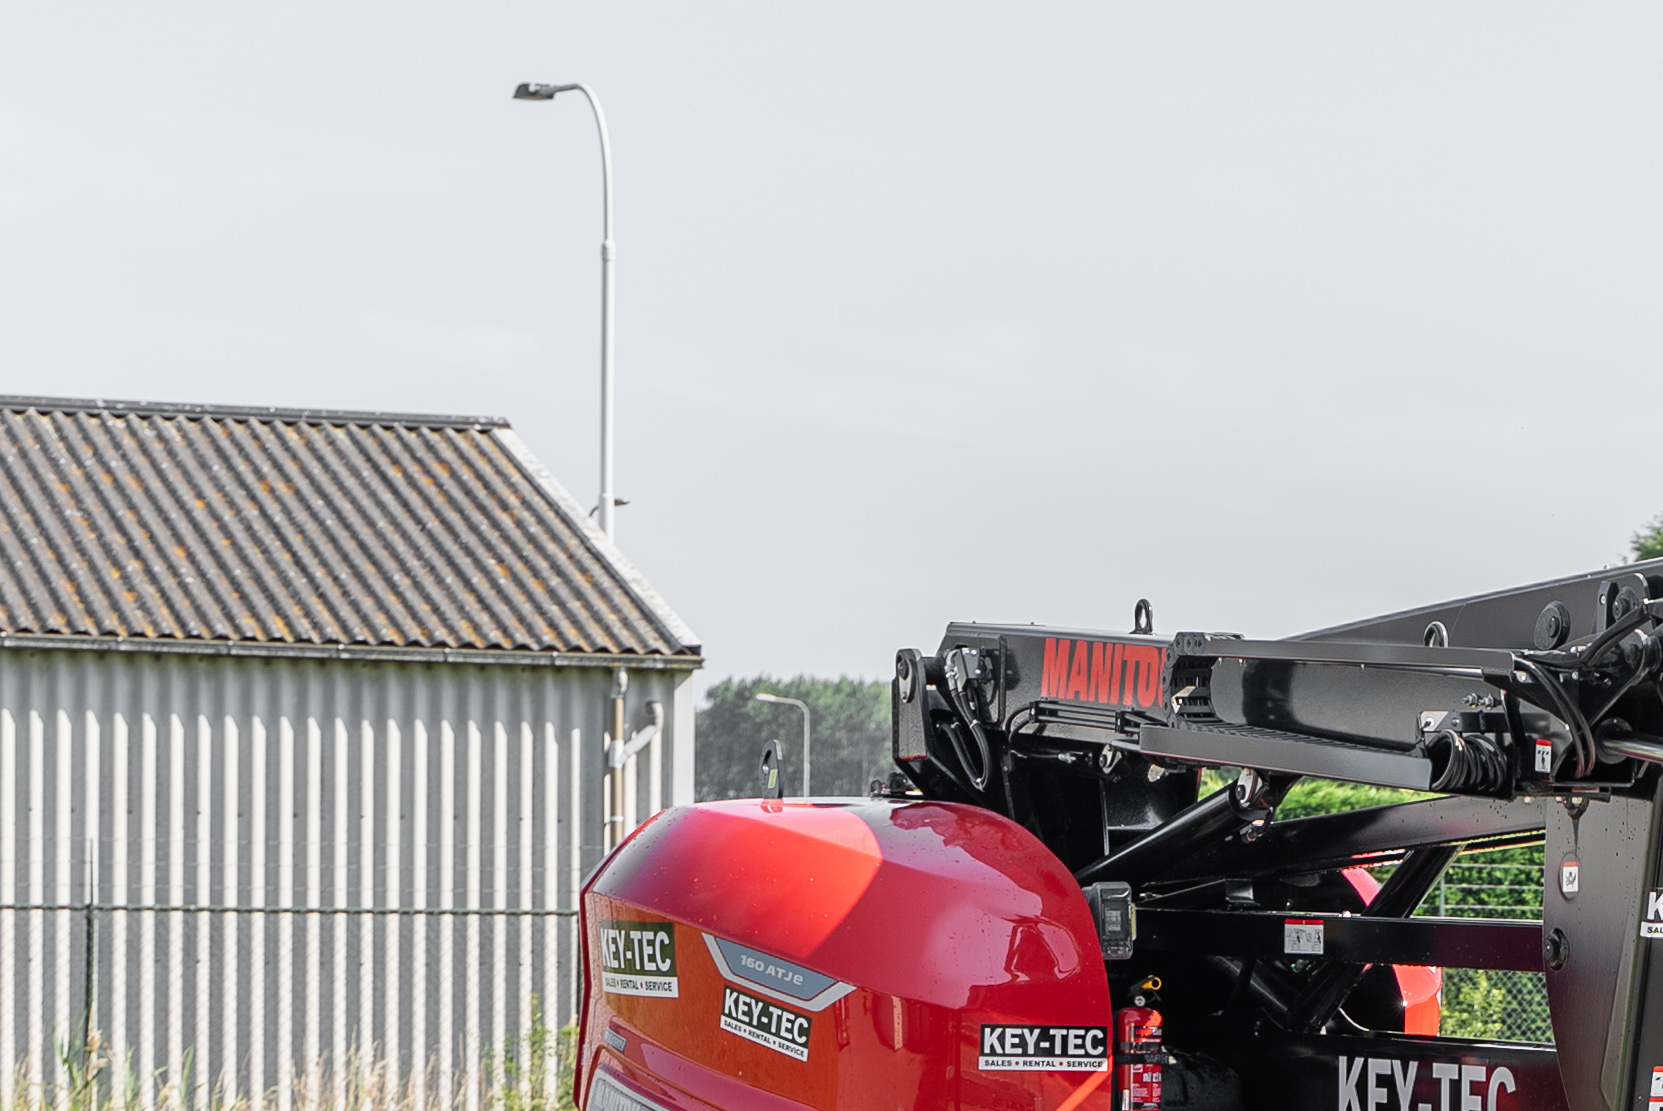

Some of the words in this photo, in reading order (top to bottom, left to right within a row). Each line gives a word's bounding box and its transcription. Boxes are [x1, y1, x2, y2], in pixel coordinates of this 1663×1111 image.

[1041, 637, 1166, 708] MANITO
[600, 928, 671, 972] KEY-TEC
[740, 954, 764, 972] 160
[604, 976, 616, 987] SALES
[620, 977, 639, 990] RENTAL
[644, 980, 672, 992] SERVICE
[724, 988, 808, 1044] KEY-TEC
[724, 1019, 742, 1033] SALES
[748, 1029, 771, 1045] RENTAL
[777, 1039, 805, 1058] SERVICE
[983, 1028, 1104, 1056] KEY-TEC
[984, 1059, 1012, 1067] SALES
[1022, 1060, 1056, 1068] RENTAL
[1066, 1060, 1103, 1068] SERVICE
